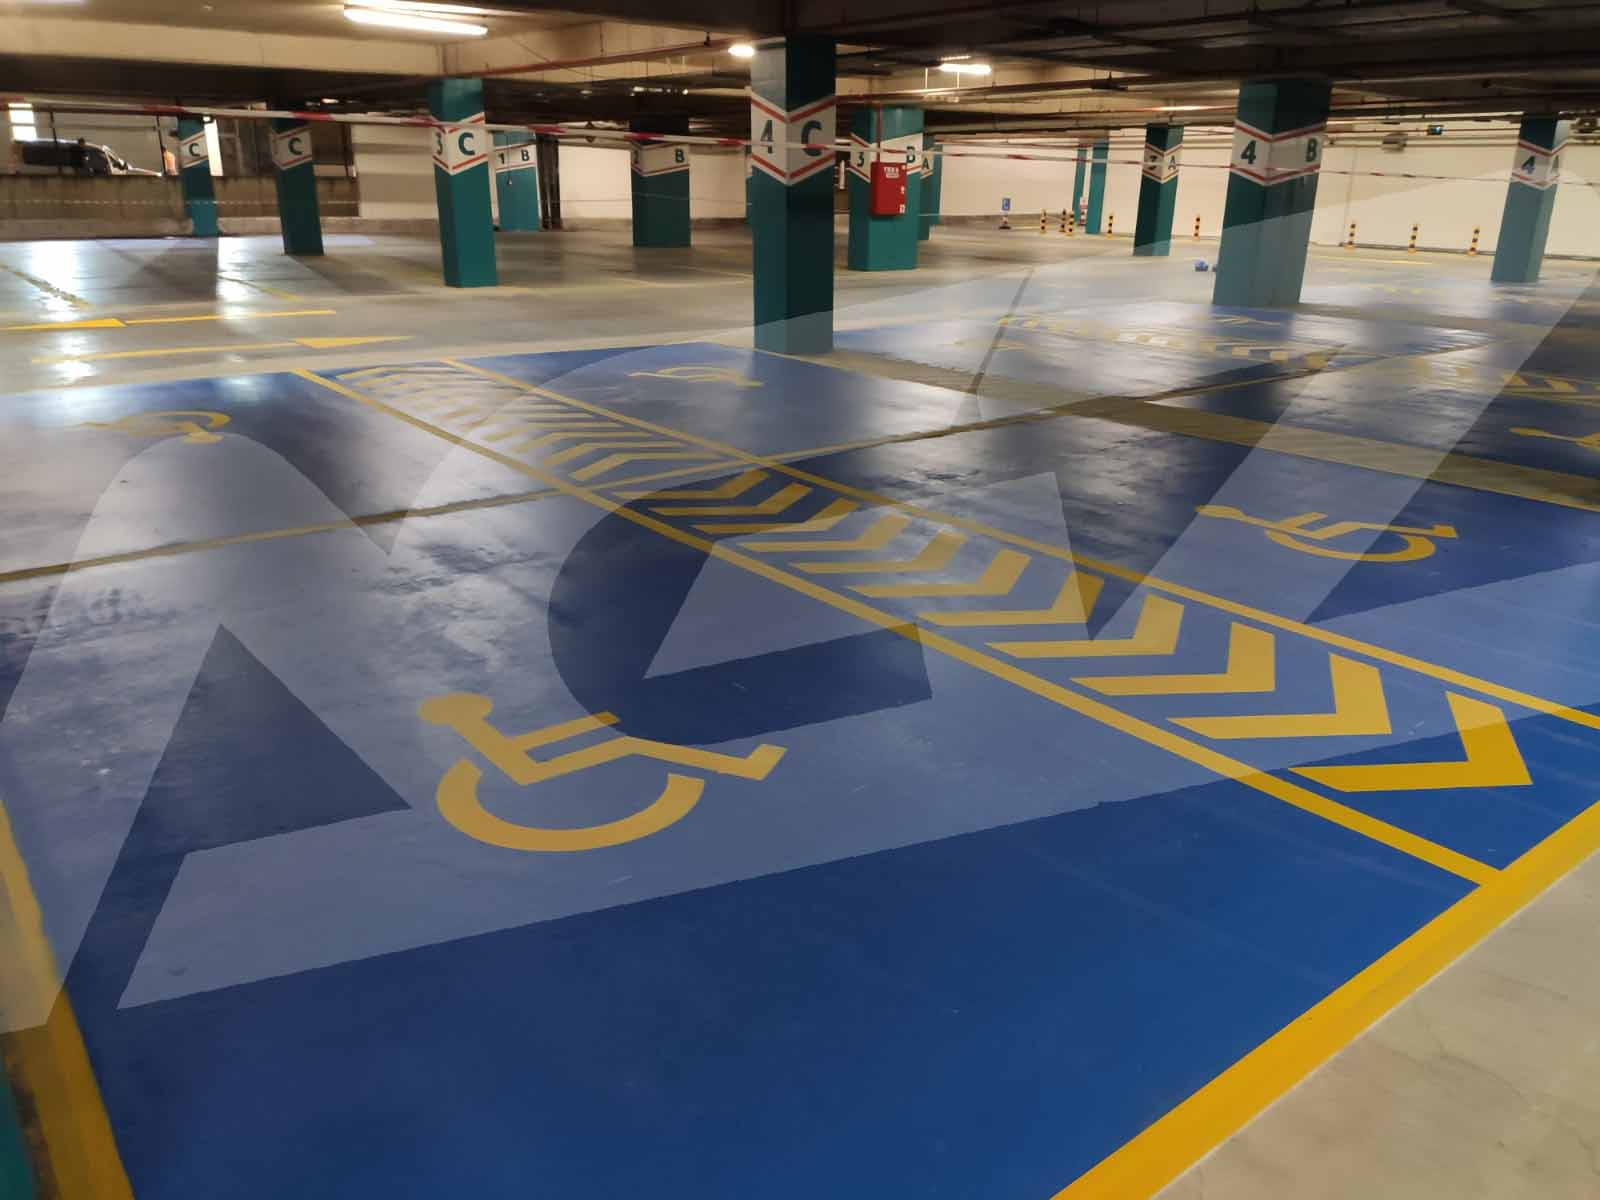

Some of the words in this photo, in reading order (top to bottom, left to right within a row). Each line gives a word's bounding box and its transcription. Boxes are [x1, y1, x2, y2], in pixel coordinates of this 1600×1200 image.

[288, 136, 305, 156] C
[458, 131, 476, 156] C
[760, 119, 774, 155] 4
[800, 119, 823, 157] C
[188, 142, 201, 157] C
[520, 148, 530, 162] B
[674, 147, 685, 164] B
[1240, 139, 1257, 165] 4
[1305, 137, 1319, 163] B
